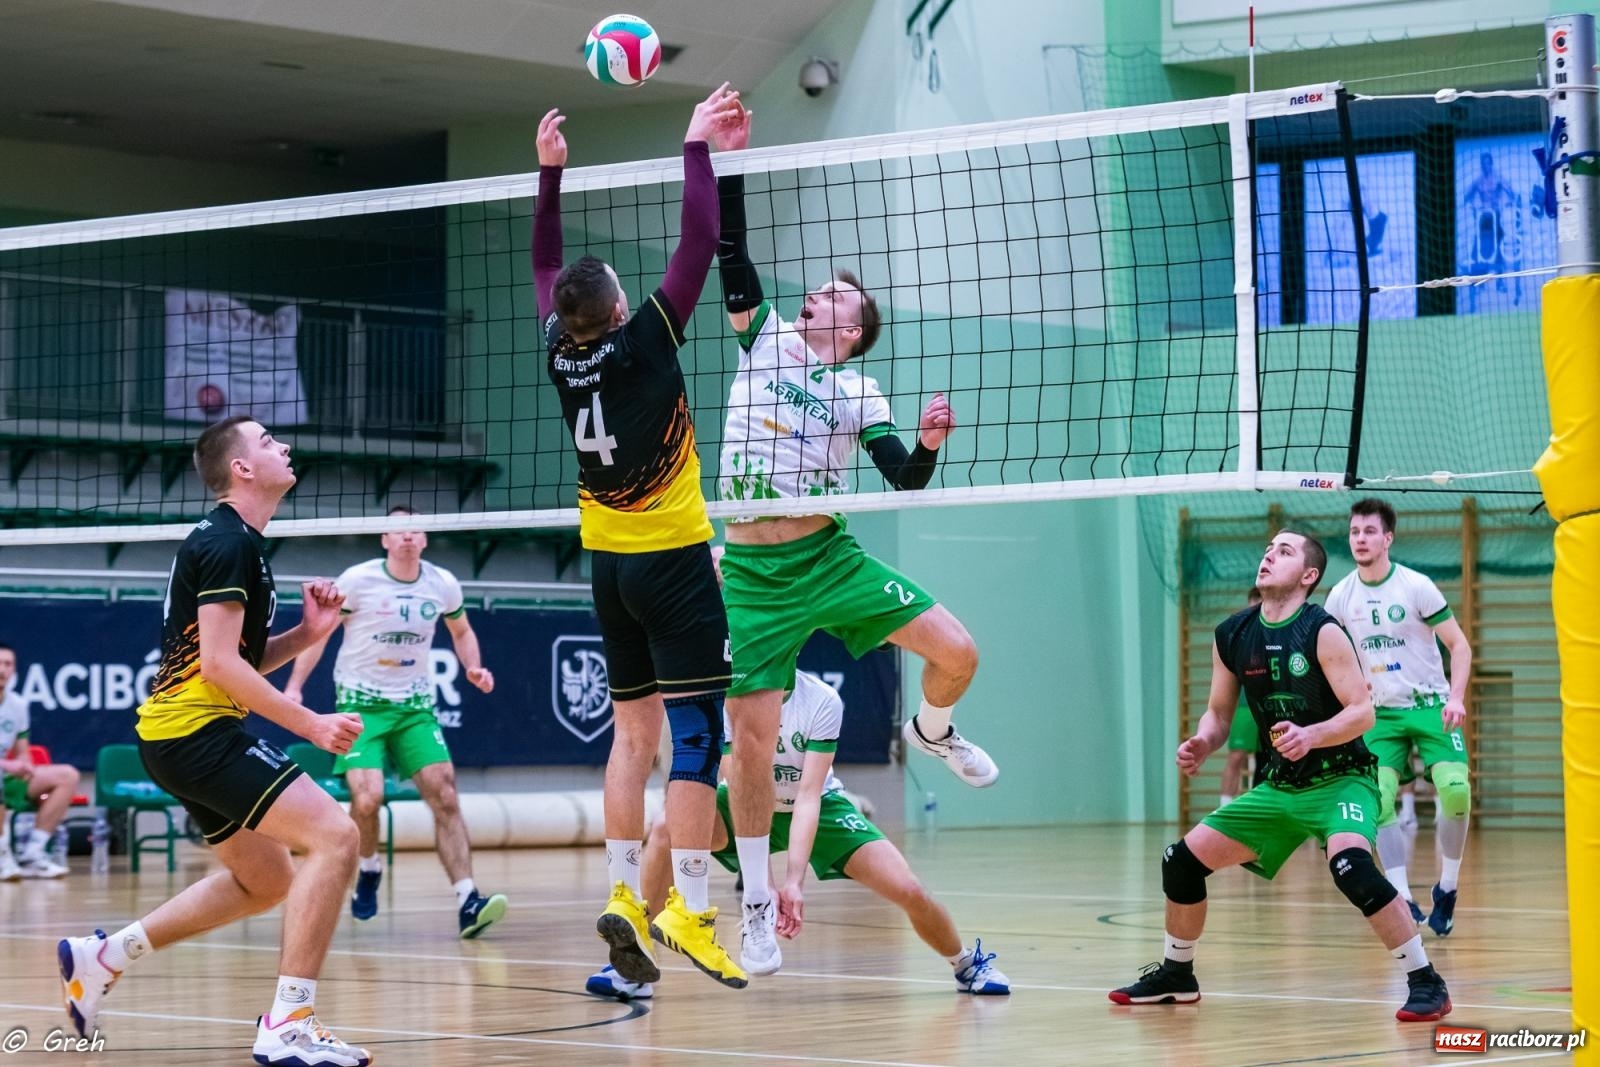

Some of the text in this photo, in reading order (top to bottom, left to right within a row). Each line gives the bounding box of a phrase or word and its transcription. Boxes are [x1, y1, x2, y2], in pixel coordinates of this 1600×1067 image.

[1290, 92, 1323, 106] netex
[574, 391, 618, 467] 4
[1300, 478, 1334, 489] netex
[883, 580, 916, 606] 2
[400, 604, 410, 623] 4
[1372, 609, 1381, 626] 6
[1360, 638, 1406, 651] GROTEAM
[8, 648, 163, 710] ACIBÓ
[1450, 732, 1463, 751] 6
[1337, 801, 1364, 822] 15
